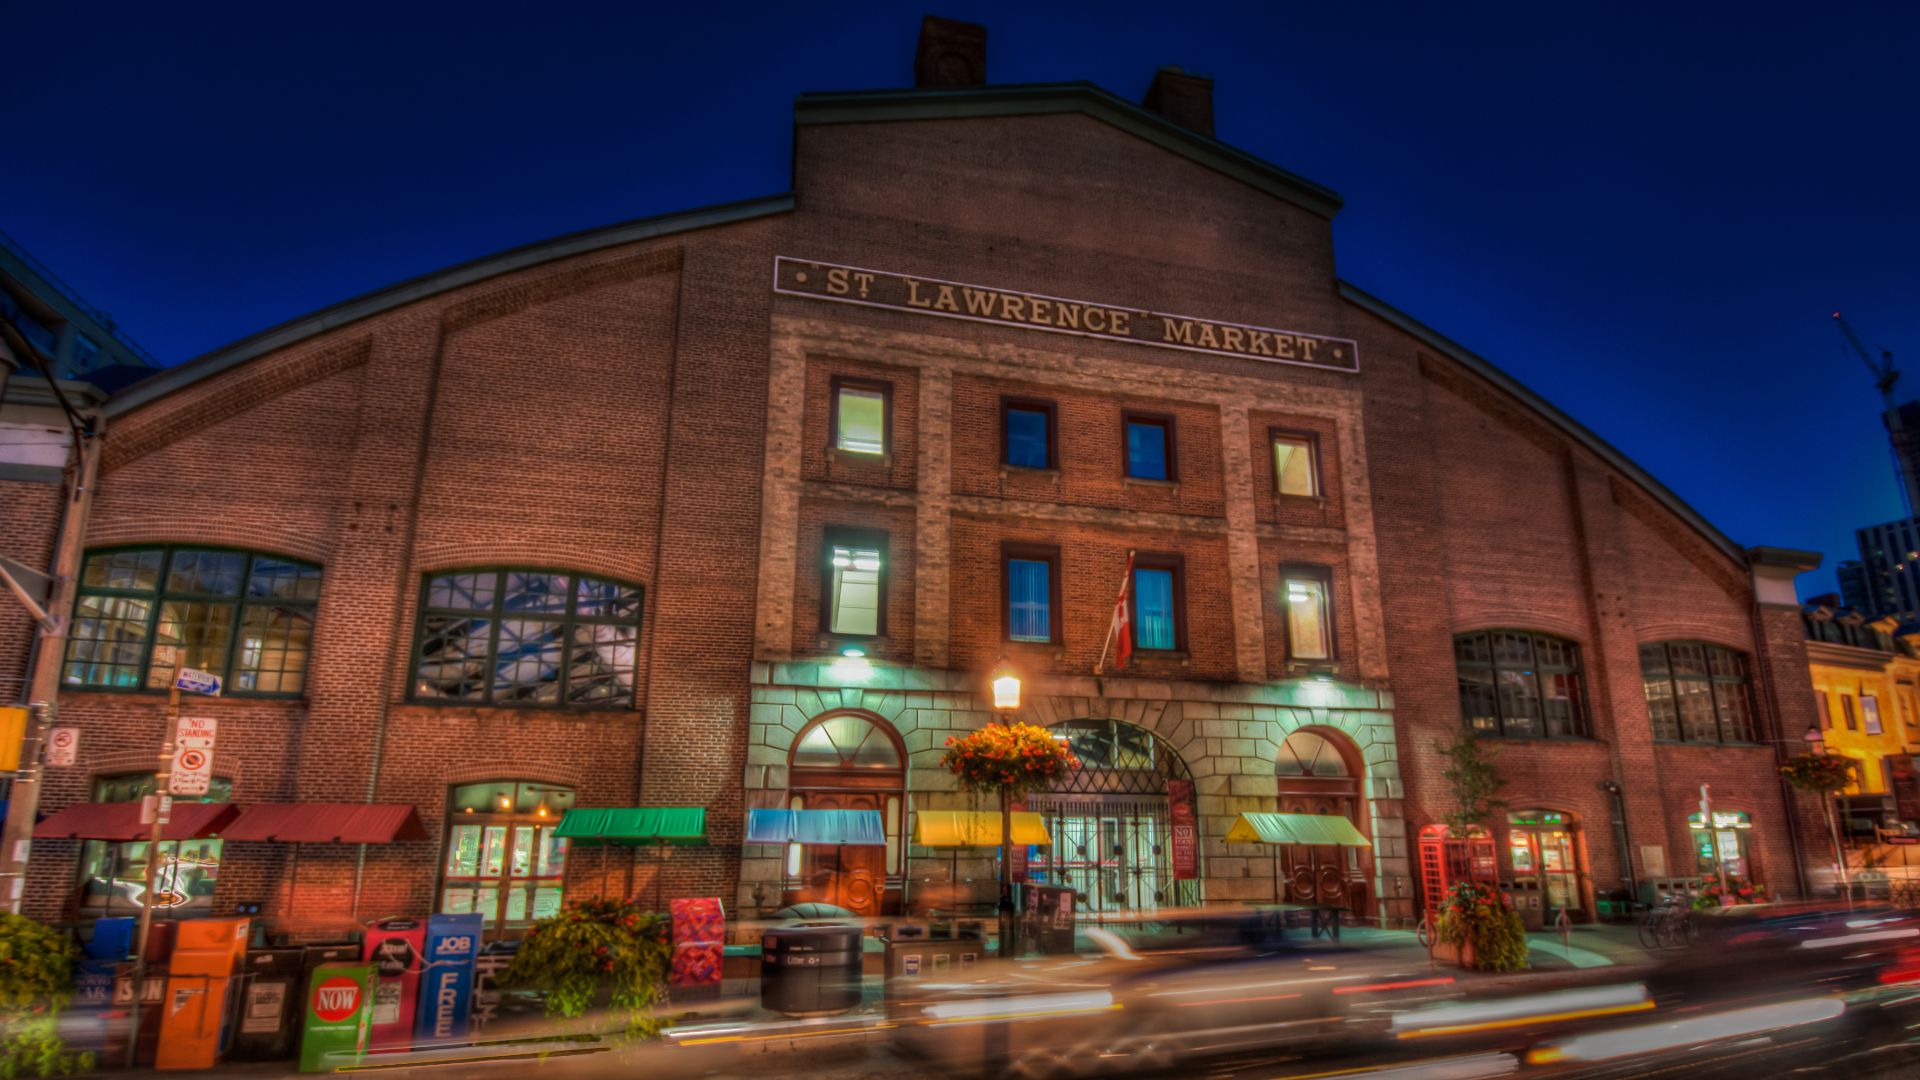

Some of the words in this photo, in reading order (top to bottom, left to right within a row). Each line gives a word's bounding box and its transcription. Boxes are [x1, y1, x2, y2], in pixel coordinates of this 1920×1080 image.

[905, 280, 1131, 336] LAWRENCE
[1162, 317, 1318, 361] MARKET
[190, 719, 205, 728] NO
[179, 728, 215, 738] STANDING
[436, 936, 472, 950] JOB
[317, 989, 358, 1011] NOW
[434, 972, 459, 1038] FREE
